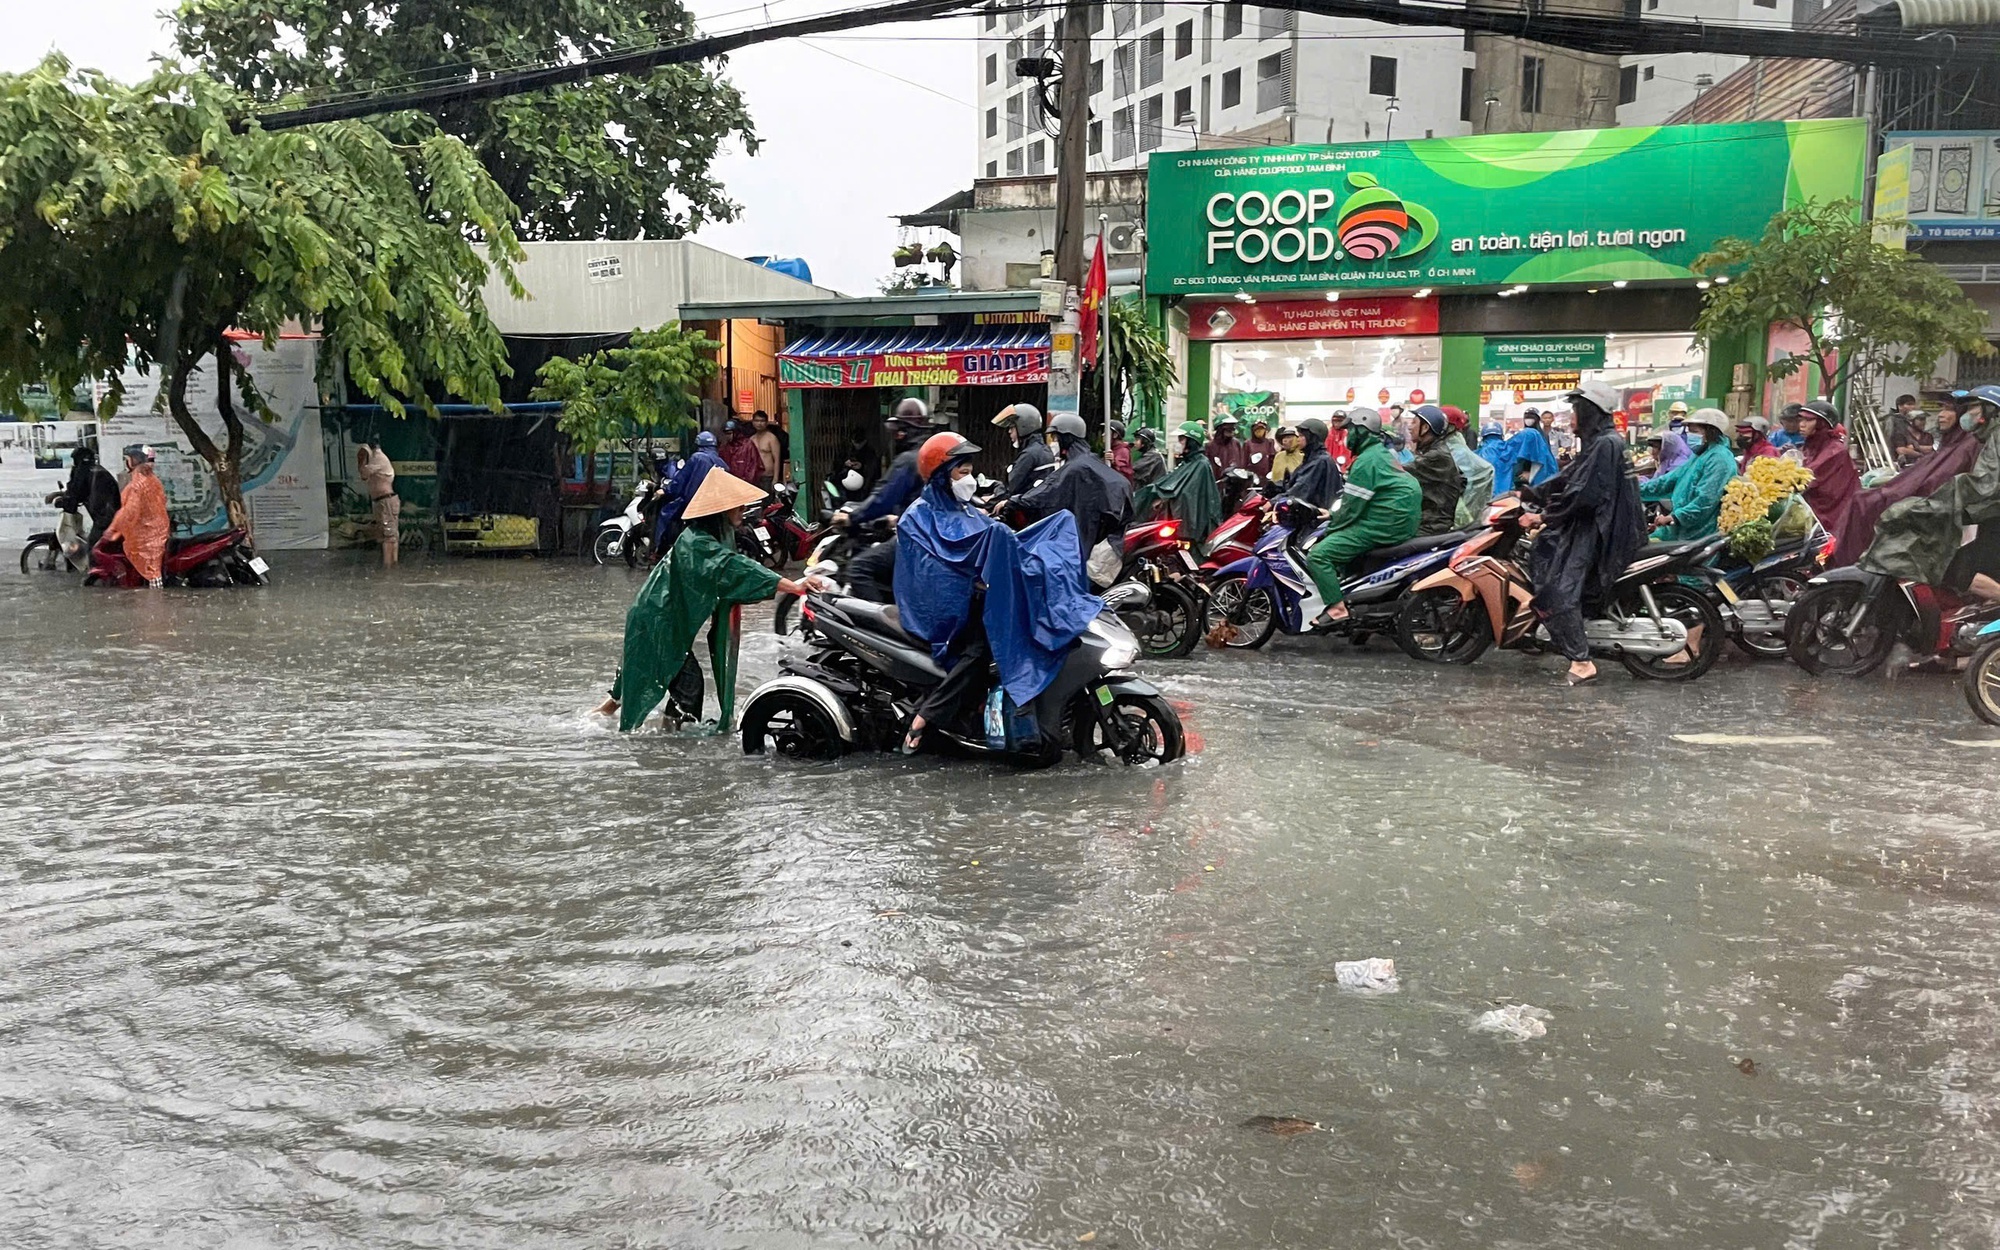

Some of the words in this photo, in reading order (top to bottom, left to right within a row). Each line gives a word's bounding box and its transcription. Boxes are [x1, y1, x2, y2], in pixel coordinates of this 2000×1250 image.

[1177, 159, 1191, 167] CHI
[1192, 156, 1223, 167] NHÁNH
[1223, 155, 1247, 165] CÔNG
[1248, 155, 1261, 164] TY
[1262, 154, 1286, 163] TNHH
[1286, 153, 1306, 162] MTV
[1308, 152, 1320, 161] TP
[1233, 166, 1257, 176] HÀNG
[1305, 164, 1325, 173] TAM
[1206, 188, 1335, 228] CO.OP
[1451, 237, 1473, 252] an
[1529, 230, 1563, 252] tiện
[1597, 229, 1634, 246] tươi
[1637, 228, 1685, 249] ngon
[1299, 273, 1318, 282] TAM
[1452, 267, 1476, 276] MINH
[1359, 307, 1381, 317] NAM
[963, 349, 1028, 373] GIẢM
[846, 358, 872, 384] 77
[874, 370, 905, 387] KHAI
[1005, 374, 1016, 382] 21
